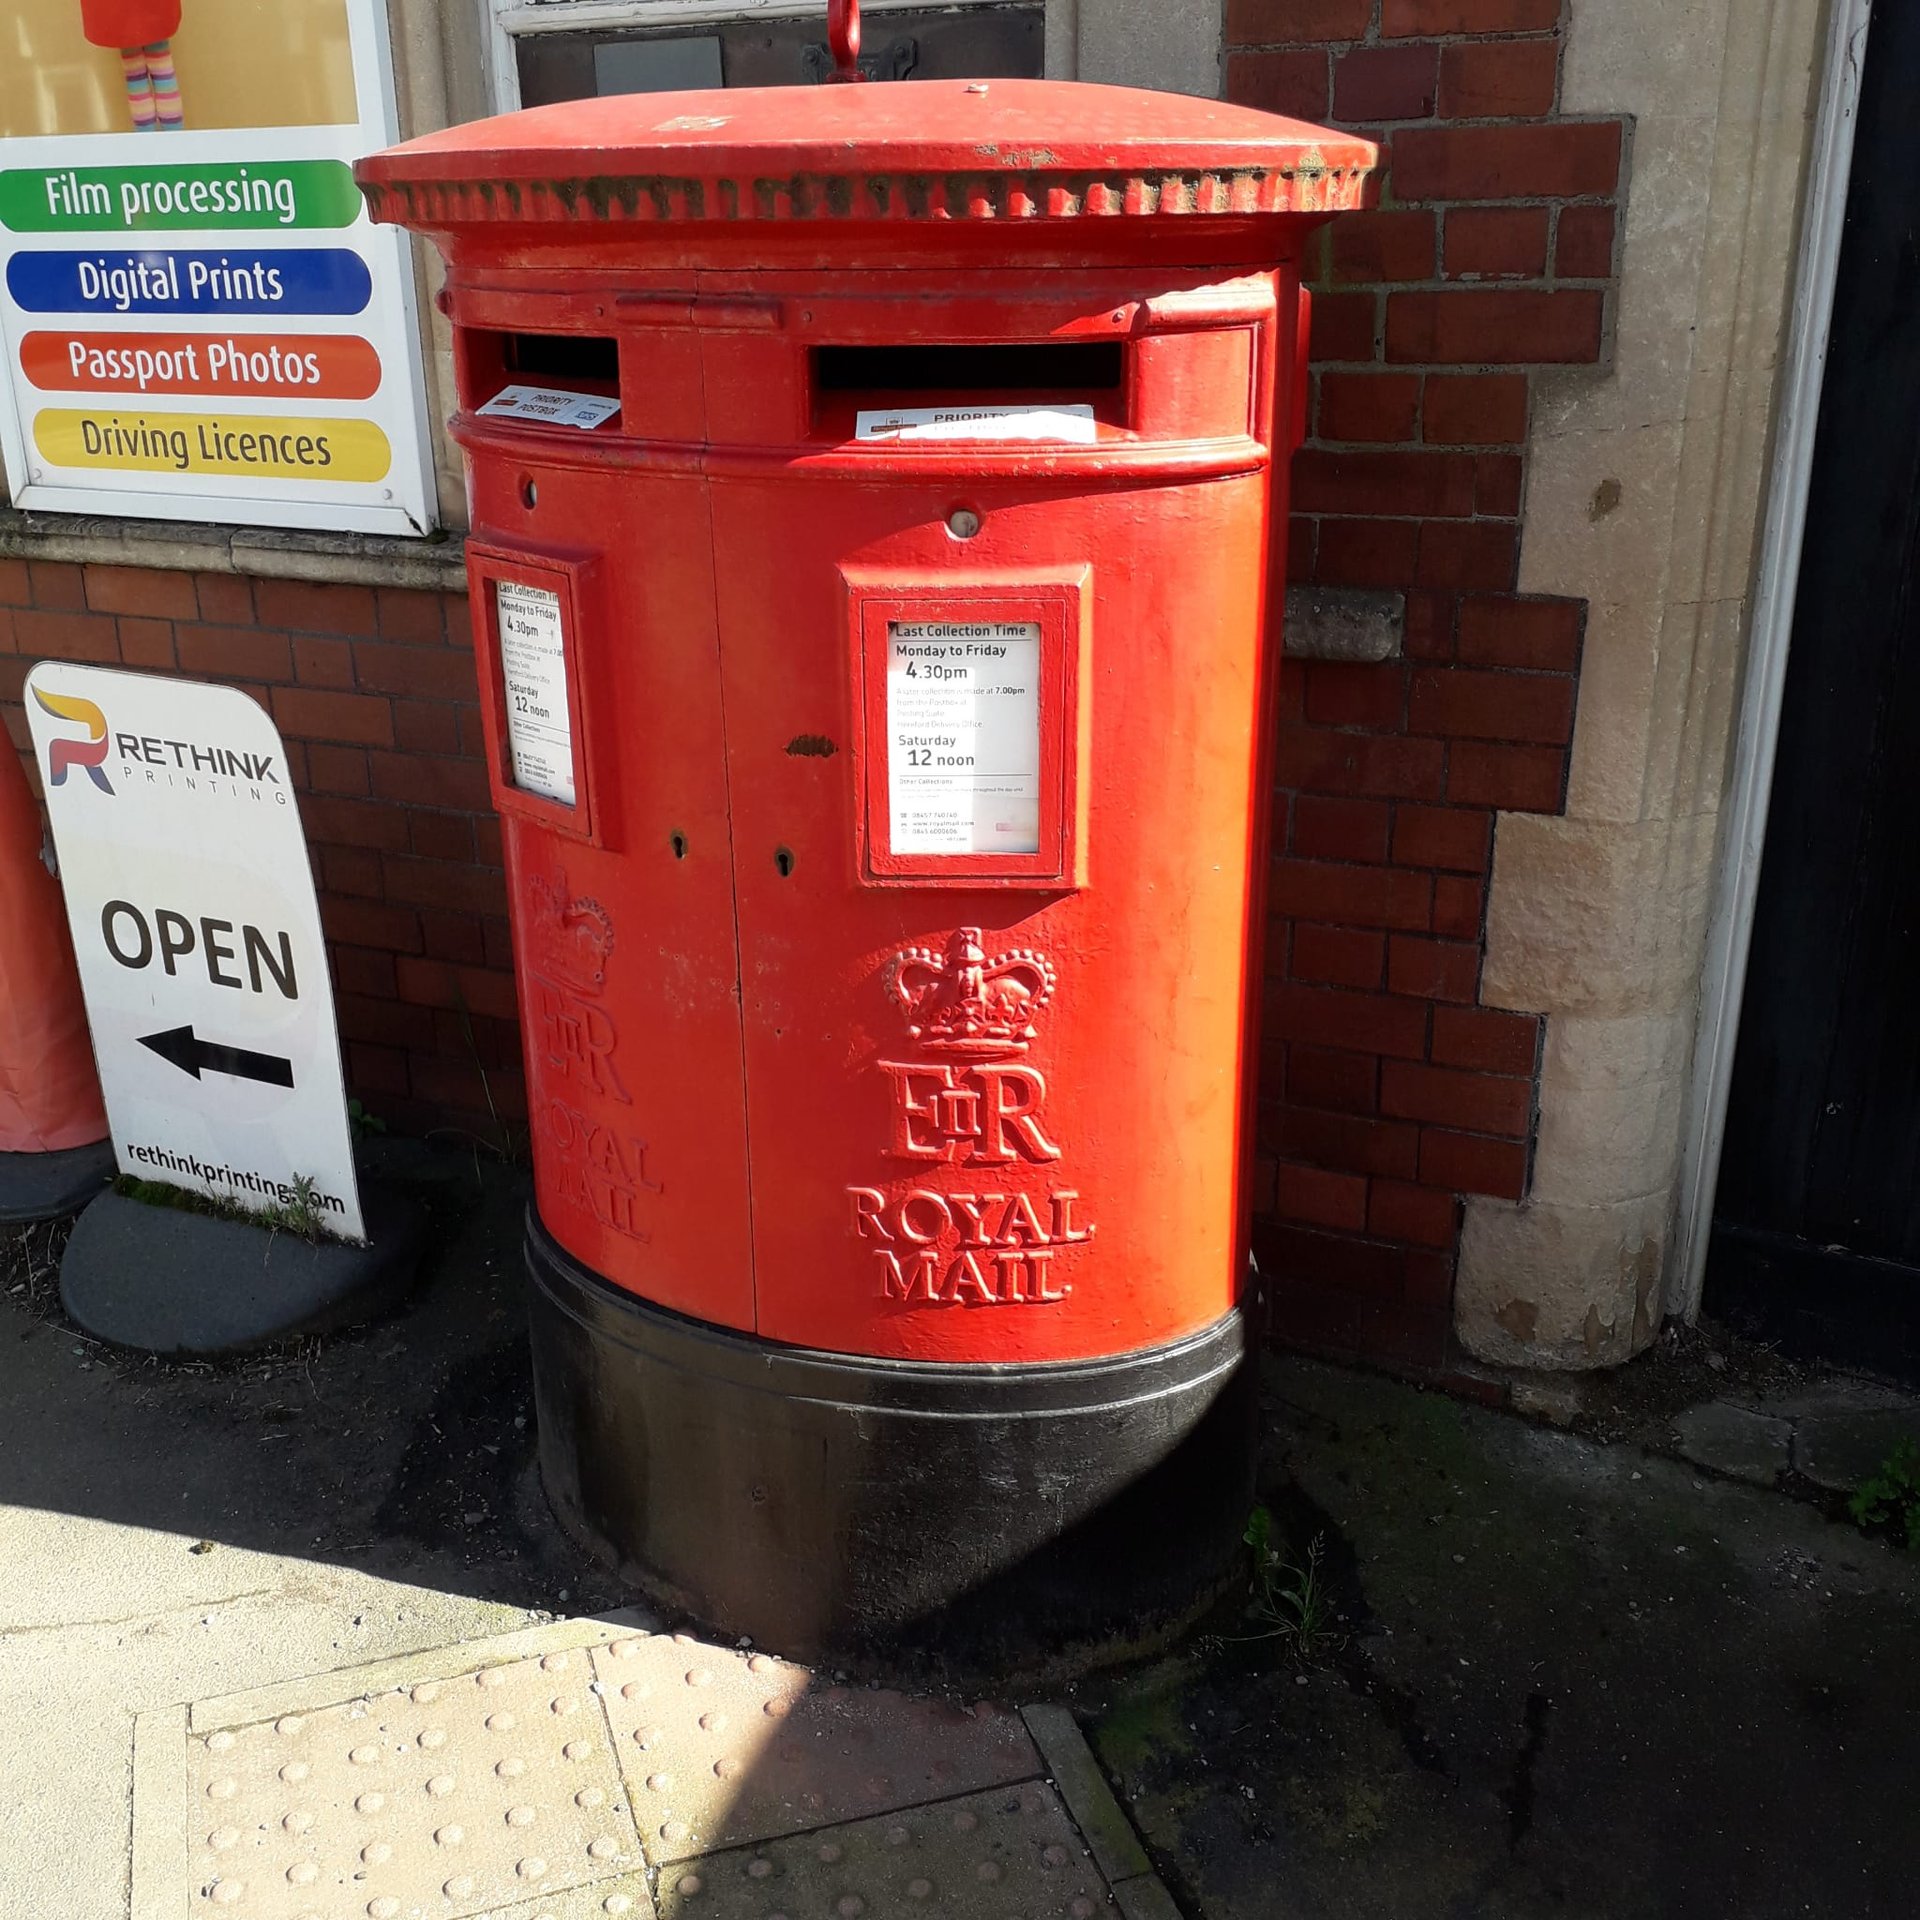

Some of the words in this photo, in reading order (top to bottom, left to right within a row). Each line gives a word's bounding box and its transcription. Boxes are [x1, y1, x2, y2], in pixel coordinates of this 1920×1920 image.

[45, 172, 112, 215] Film
[120, 168, 296, 225] processing
[78, 256, 179, 311] Digital
[188, 258, 284, 300] Prints
[68, 341, 200, 390] Passport
[207, 339, 321, 384] Photos
[516, 404, 562, 416] POSTBOX
[530, 394, 576, 406] PRIORITY
[81, 418, 189, 469] Driving
[197, 422, 332, 466] Licences
[500, 583, 514, 594] Last
[514, 586, 547, 600] Collection
[501, 599, 526, 616] Monday
[527, 605, 535, 616] to
[536, 605, 557, 622] Friday
[507, 615, 539, 638] 4.30pm
[896, 625, 923, 637] Last
[927, 624, 990, 637] Collection
[994, 624, 1026, 636] Time
[896, 645, 946, 658] Monday
[950, 646, 963, 657] to
[966, 645, 1007, 658] Friday
[906, 661, 968, 681] 4.30pm
[509, 681, 539, 699] Saturday
[995, 687, 1025, 697] 7.00pm
[515, 695, 528, 713] 12
[530, 705, 550, 719] noon
[898, 735, 956, 748] Saturday
[116, 733, 280, 785] RETHINK
[907, 749, 932, 766] 12
[937, 755, 975, 766] noon
[123, 766, 287, 806] PRINTING
[101, 899, 299, 1000] OPEN
[126, 1142, 346, 1214] rethinkprinting.om
[845, 1186, 1096, 1247] ROYAL
[873, 1248, 1074, 1303] MAIL
